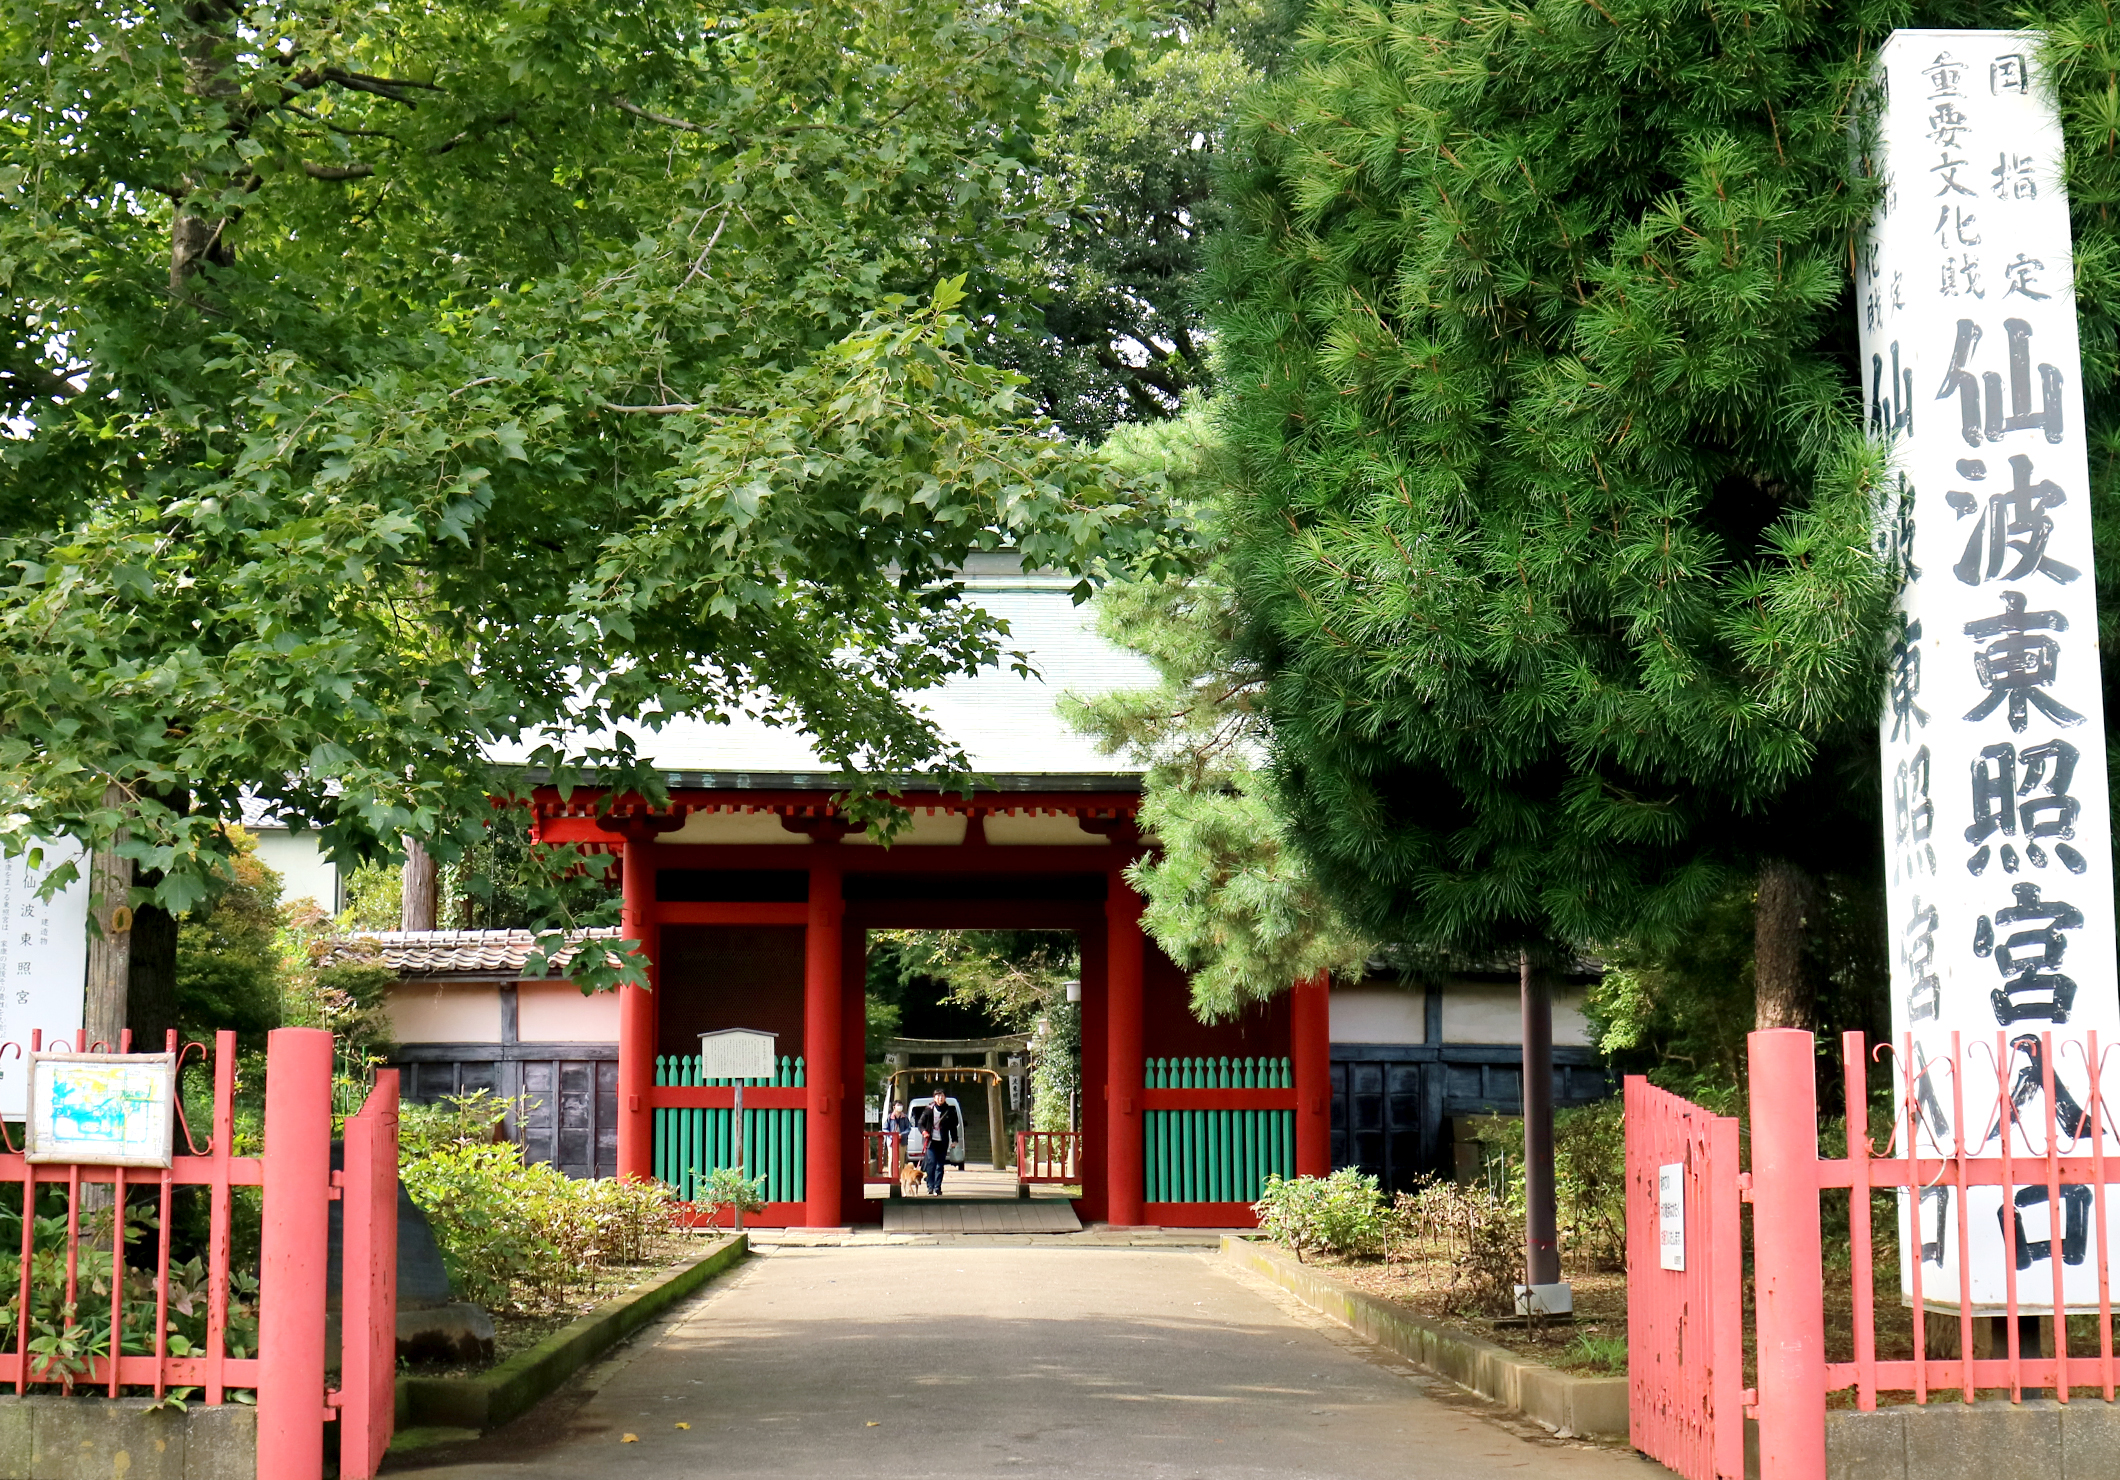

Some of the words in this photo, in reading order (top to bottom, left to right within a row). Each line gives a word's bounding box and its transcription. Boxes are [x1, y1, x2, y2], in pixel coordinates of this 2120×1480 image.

[1989, 53, 2052, 301] 国指定
[16, 874, 36, 1005] 仙波東照宮
